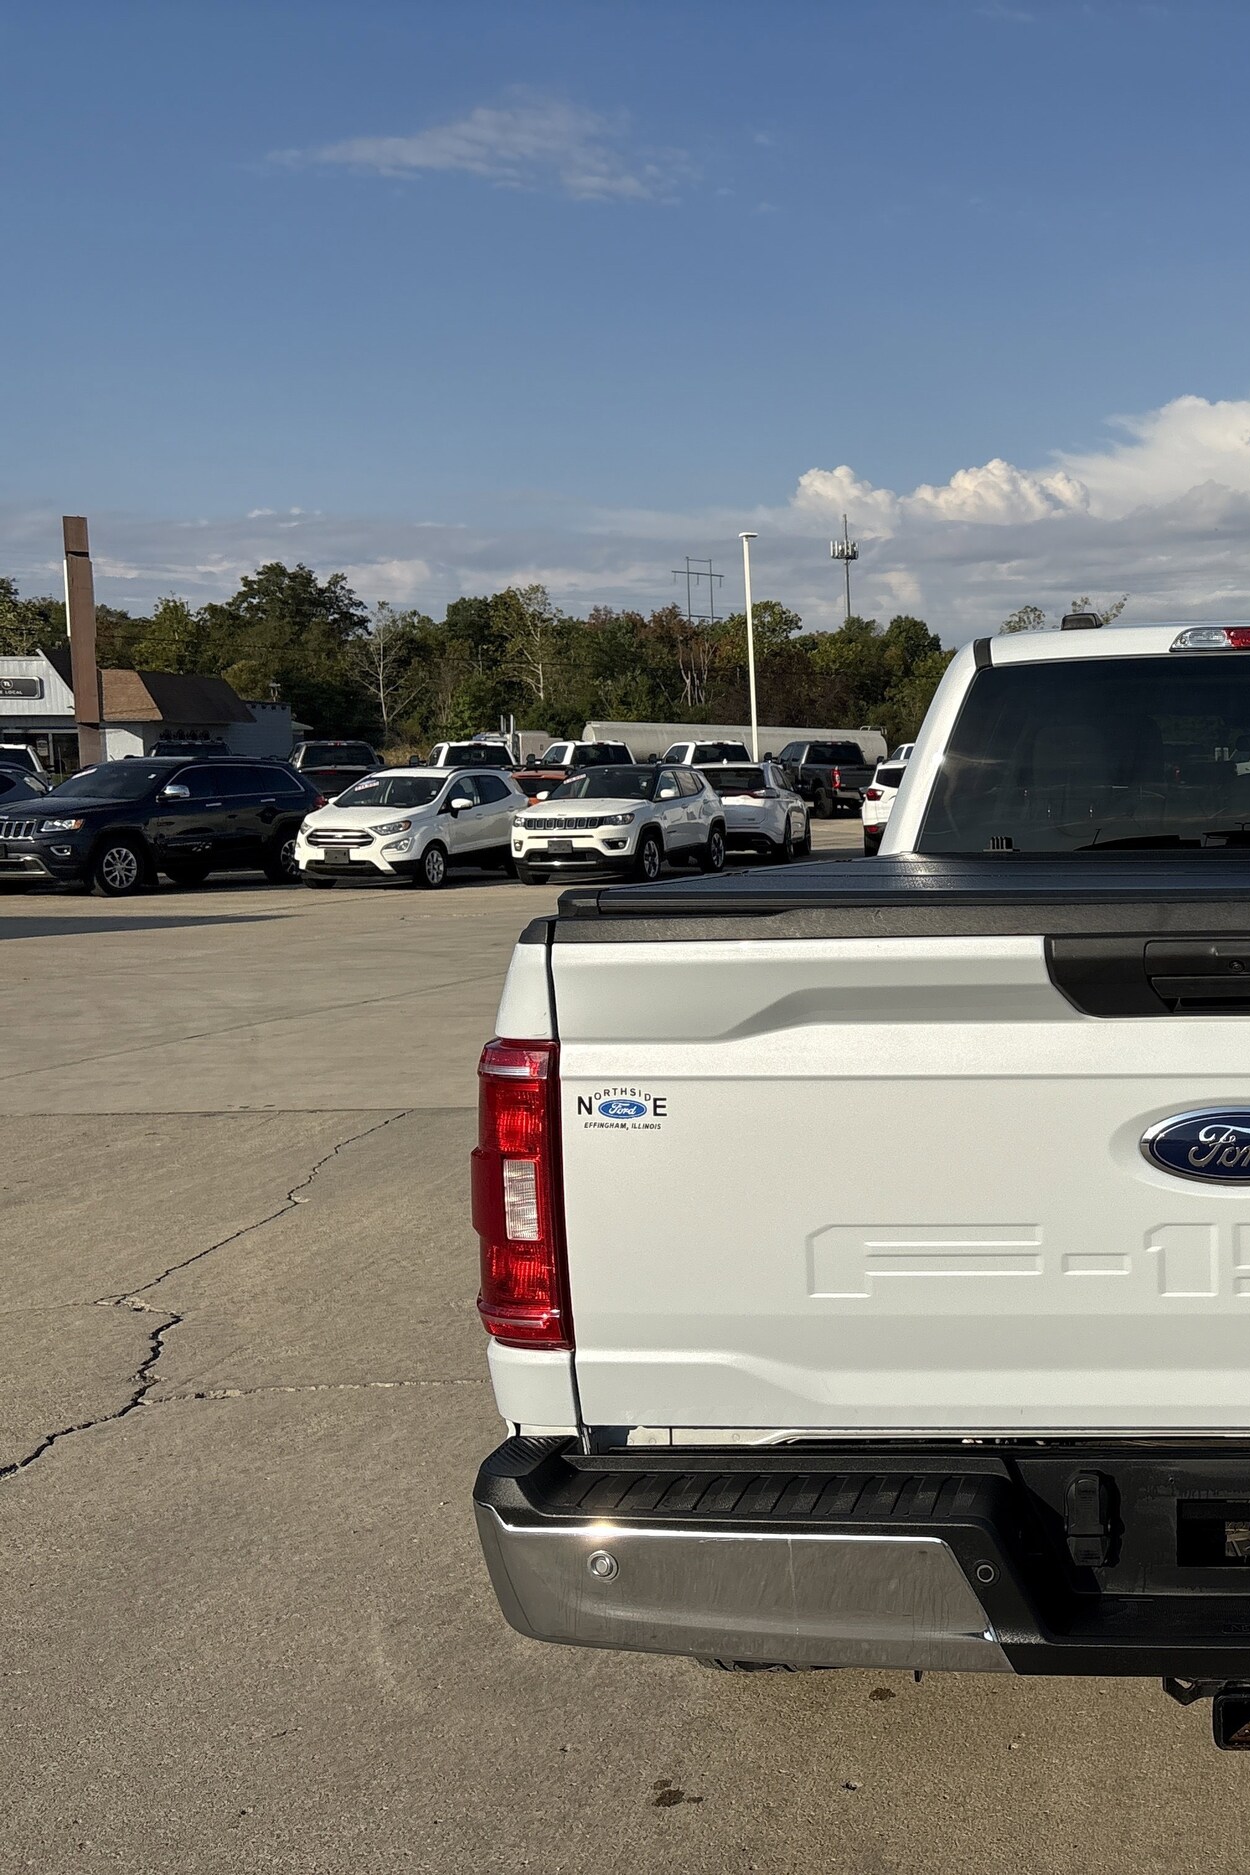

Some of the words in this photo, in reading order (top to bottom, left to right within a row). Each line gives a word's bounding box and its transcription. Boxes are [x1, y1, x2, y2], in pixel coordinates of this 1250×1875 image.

[577, 1087, 668, 1117] NORTHSIDE
[608, 1102, 637, 1115] Ford
[584, 1121, 630, 1131] EFFINGHAM,
[631, 1122, 662, 1130] ILLINOIS
